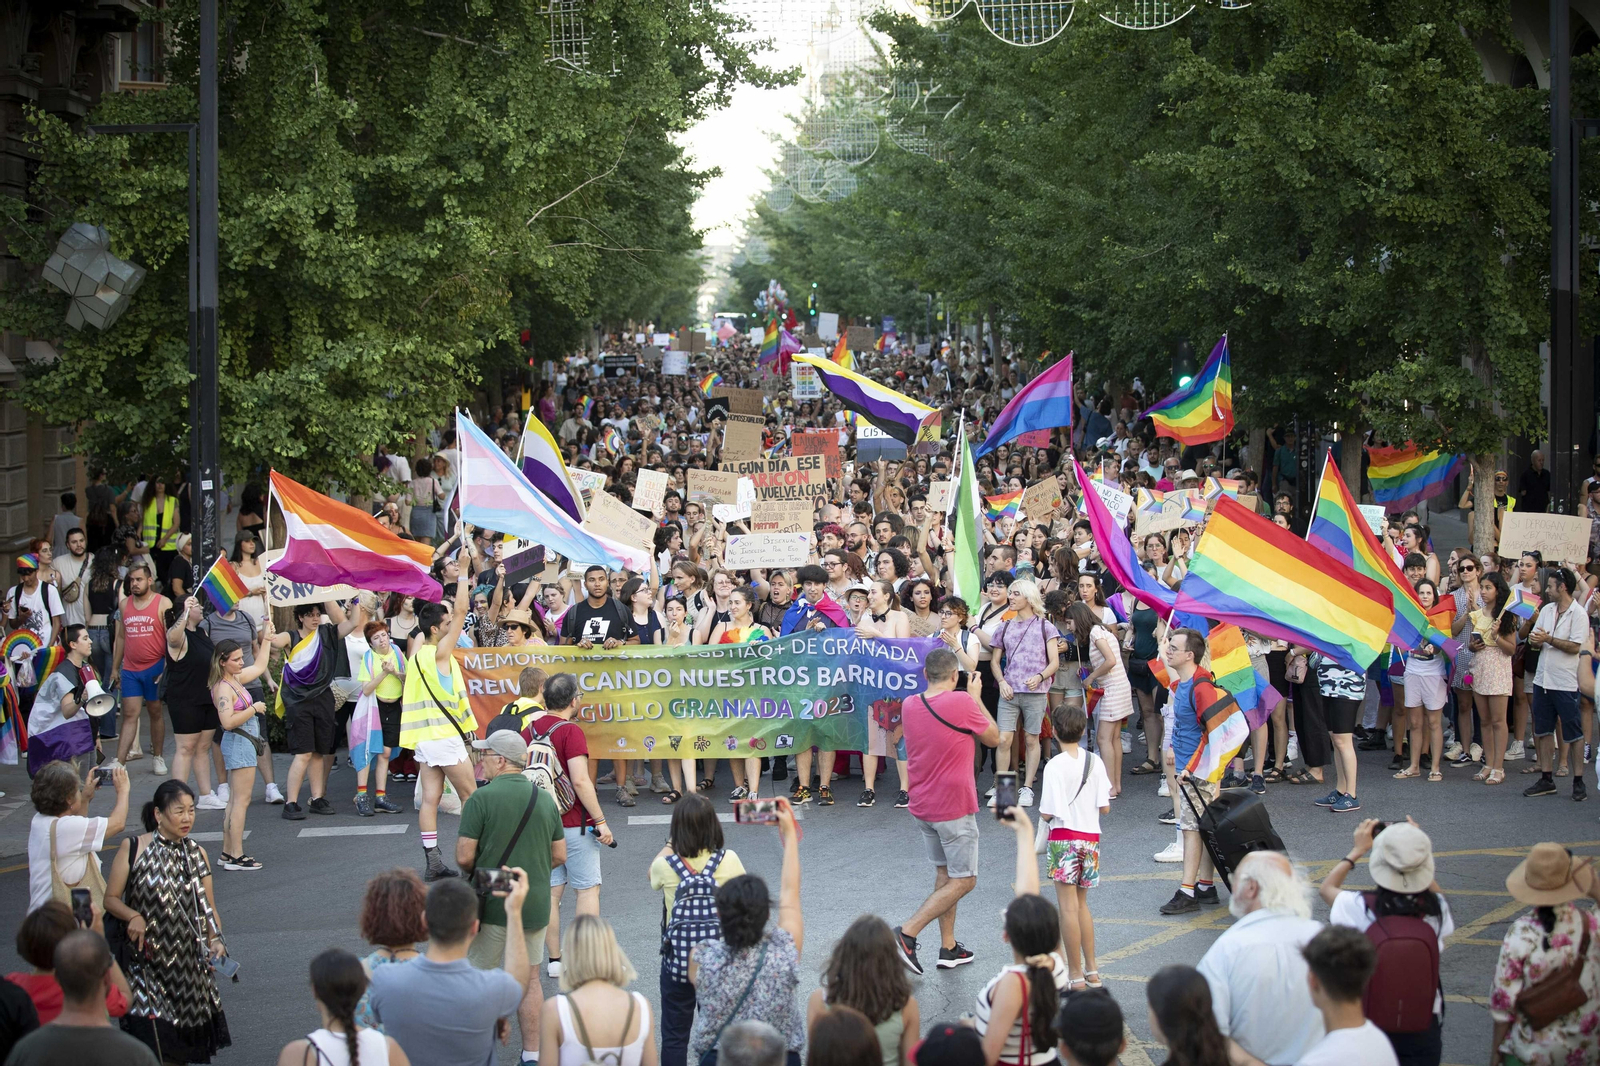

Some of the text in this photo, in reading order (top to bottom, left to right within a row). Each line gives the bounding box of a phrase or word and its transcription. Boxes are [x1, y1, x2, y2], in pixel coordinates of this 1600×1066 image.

[722, 460, 764, 474] ALGÚN
[768, 459, 790, 473] DÍA
[797, 455, 821, 471] ESE
[761, 485, 797, 499] VUELVE
[798, 484, 805, 497] A
[805, 483, 827, 496] CASA
[1102, 488, 1113, 498] NO
[1113, 493, 1125, 504] ES
[1509, 517, 1521, 529] SI
[1525, 518, 1567, 532] DEROGAN
[140, 625, 154, 633] CLUB
[791, 637, 817, 655] DE
[822, 638, 919, 664] GRANADA
[679, 665, 810, 687] NUESTROS
[817, 664, 918, 691] BARRIOS
[577, 693, 855, 722] GULLO GRANADA 2023
[693, 740, 711, 752] FARO
